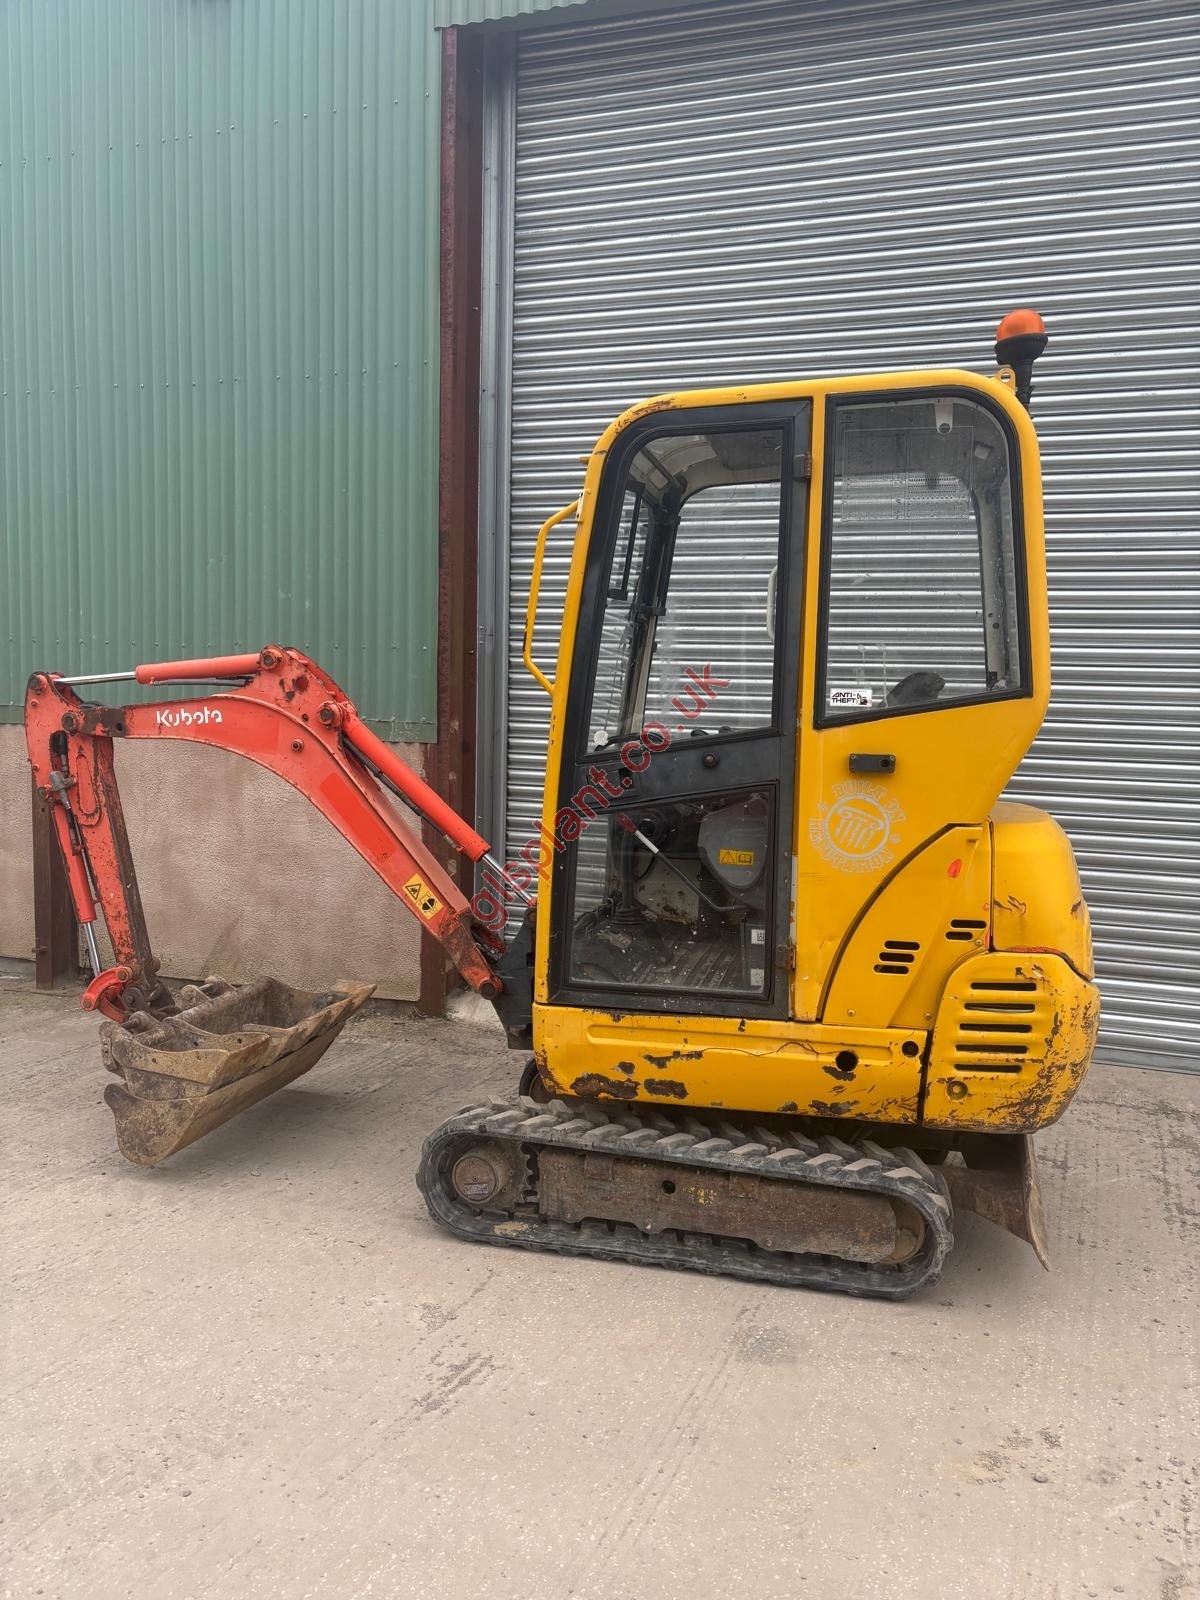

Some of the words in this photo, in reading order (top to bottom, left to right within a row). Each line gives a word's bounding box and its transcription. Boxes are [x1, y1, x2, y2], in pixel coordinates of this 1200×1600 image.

[156, 706, 223, 727] Kubota
[831, 779, 888, 801] BUILT
[886, 798, 906, 824] ON
